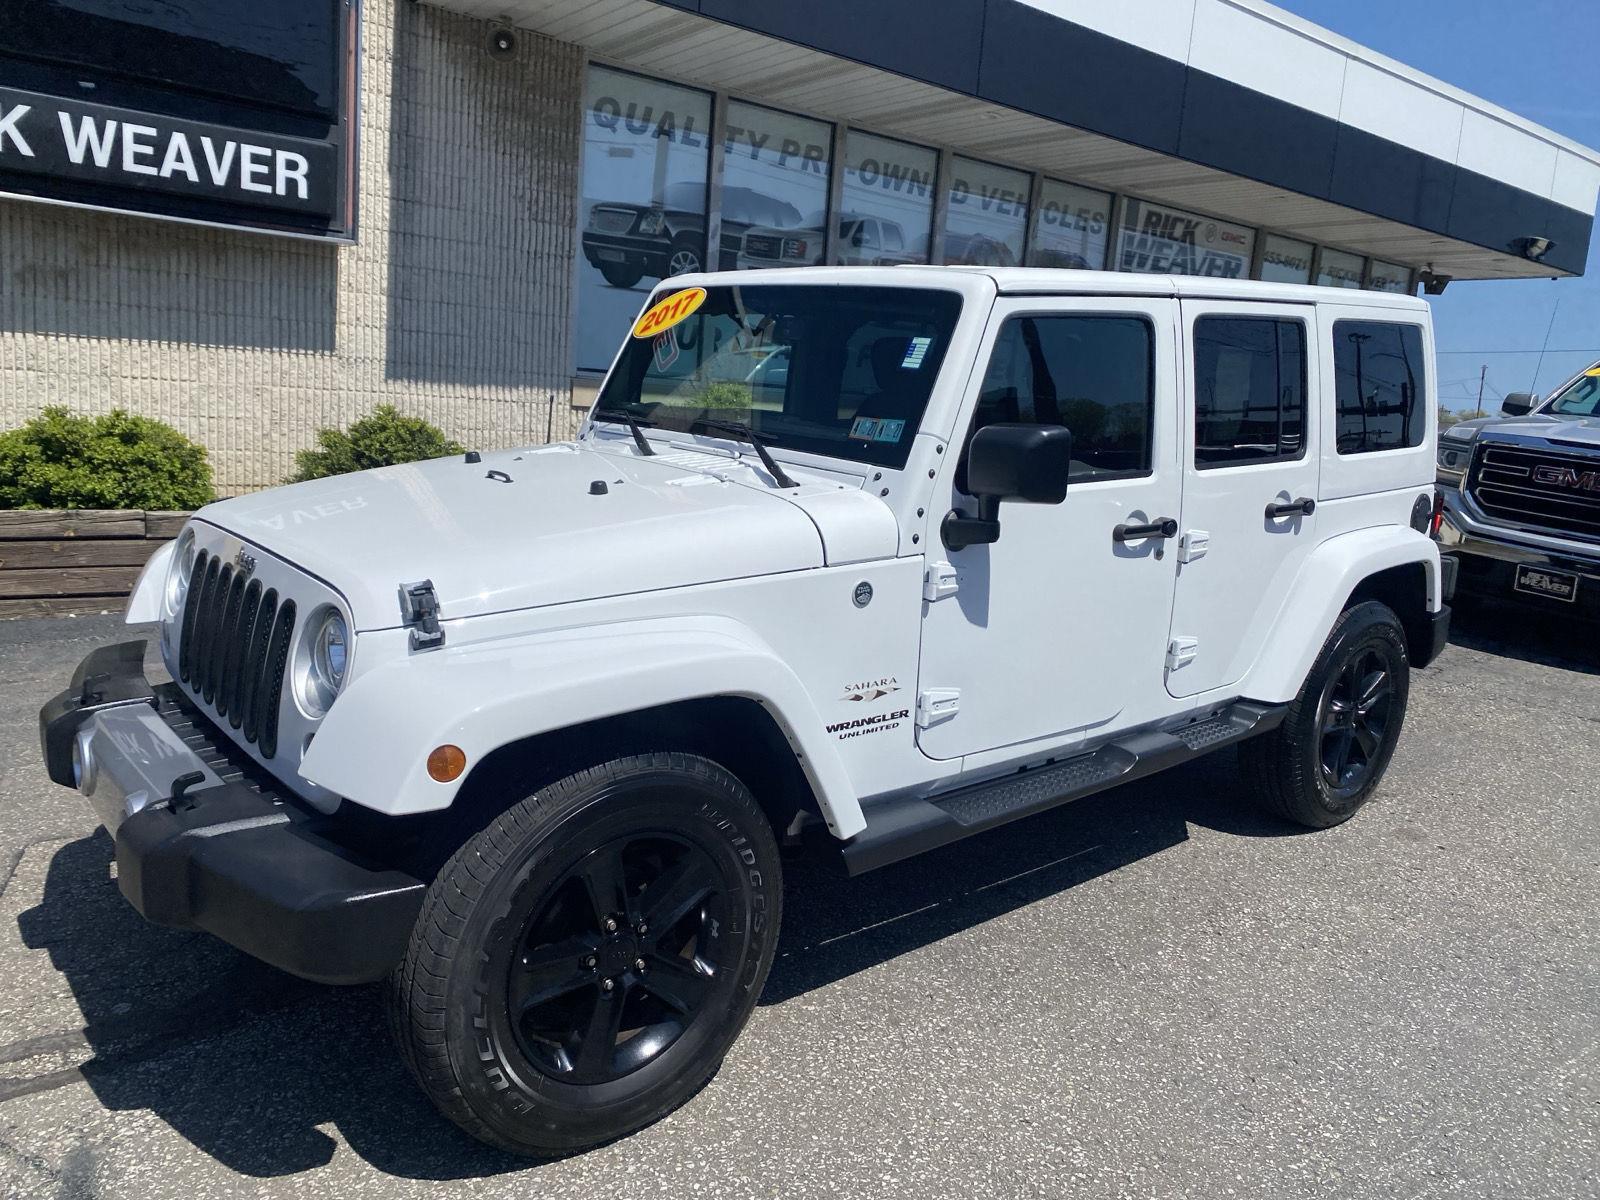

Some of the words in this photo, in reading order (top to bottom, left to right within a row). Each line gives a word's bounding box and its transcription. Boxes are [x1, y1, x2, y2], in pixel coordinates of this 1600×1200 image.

[57, 110, 309, 199] WEAVER
[592, 96, 769, 160] QUALTY
[981, 184, 1105, 235] VEHCLES
[1141, 210, 1204, 246] RICK
[1120, 231, 1243, 278] WEAVER
[640, 290, 700, 334] 2017
[844, 676, 897, 692] SAHARA
[826, 709, 910, 734] WRANGLER
[839, 722, 900, 740] UNLIMITED
